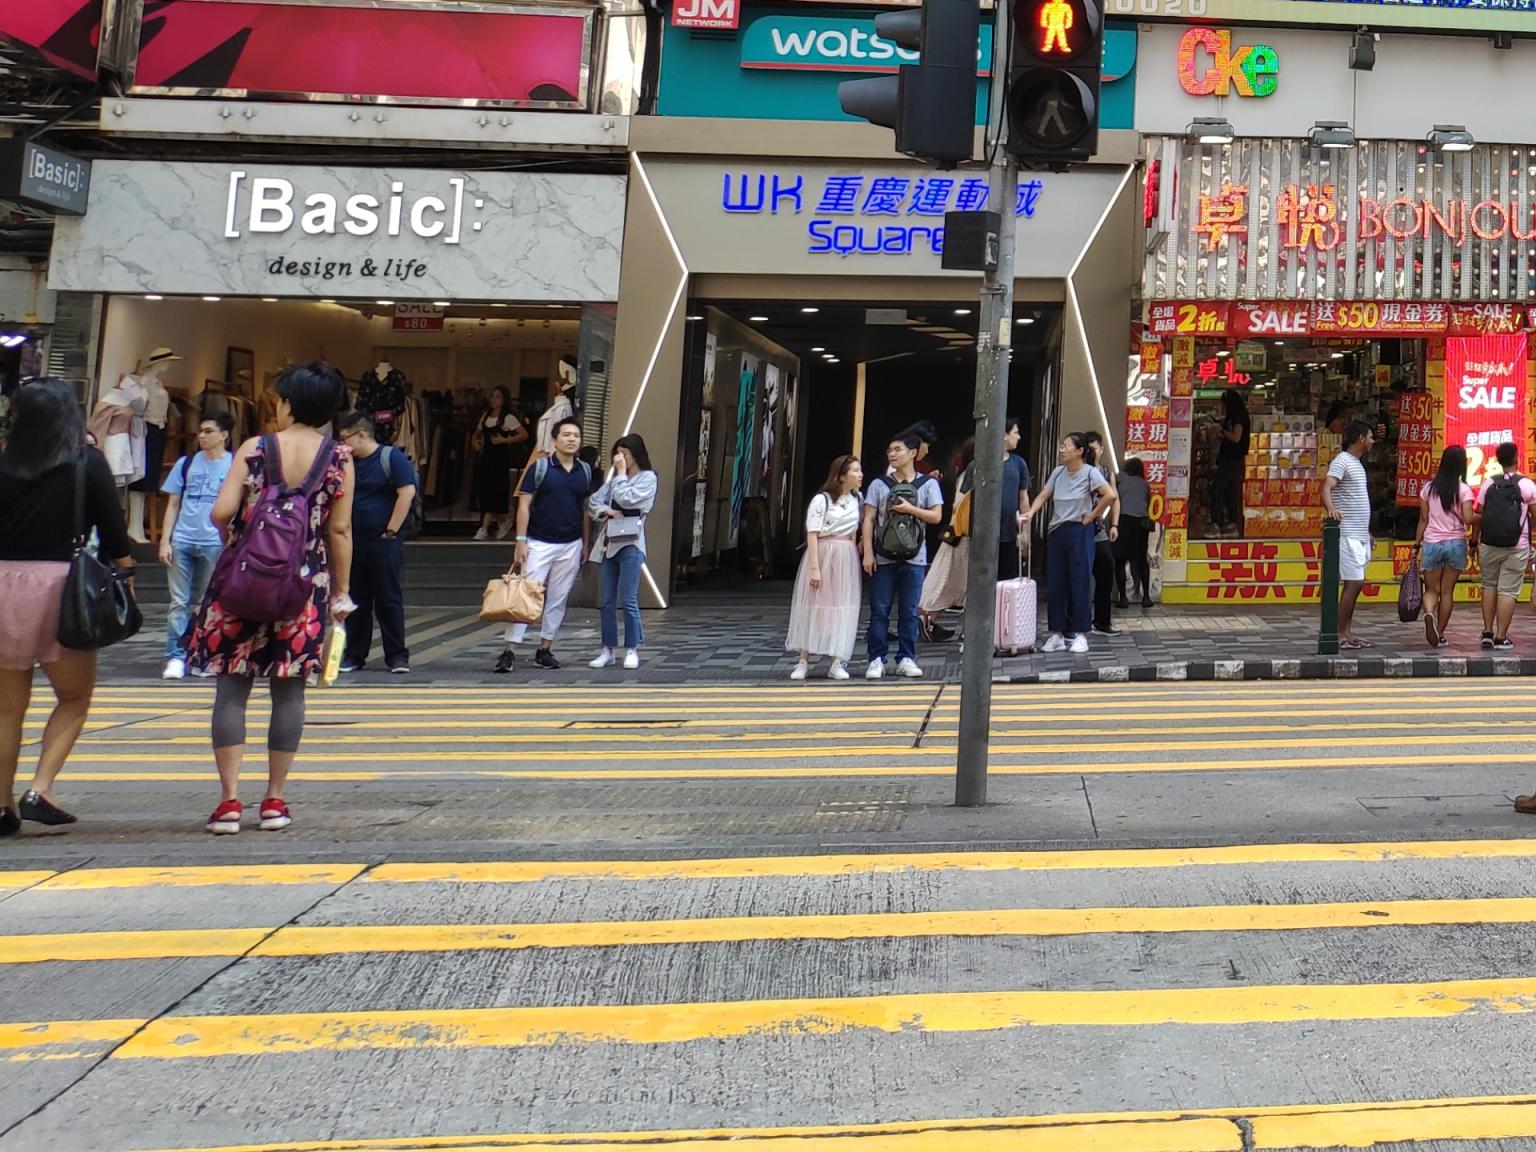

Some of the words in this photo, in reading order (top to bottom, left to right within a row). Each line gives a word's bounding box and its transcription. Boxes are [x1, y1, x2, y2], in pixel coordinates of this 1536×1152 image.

[678, 0, 734, 18] JM
[677, 19, 733, 27] NETWORK
[1177, 27, 1280, 97] Cke
[722, 173, 803, 214] WK
[268, 256, 353, 278] design
[360, 259, 378, 278] &
[384, 258, 428, 280] life
[1237, 302, 1259, 311] Super
[1338, 303, 1378, 329] $50
[1382, 303, 1444, 322] 現金券
[1248, 310, 1307, 333] SALE
[1316, 322, 1334, 330] Free
[1463, 376, 1488, 386] Super
[1459, 387, 1516, 409] SALE
